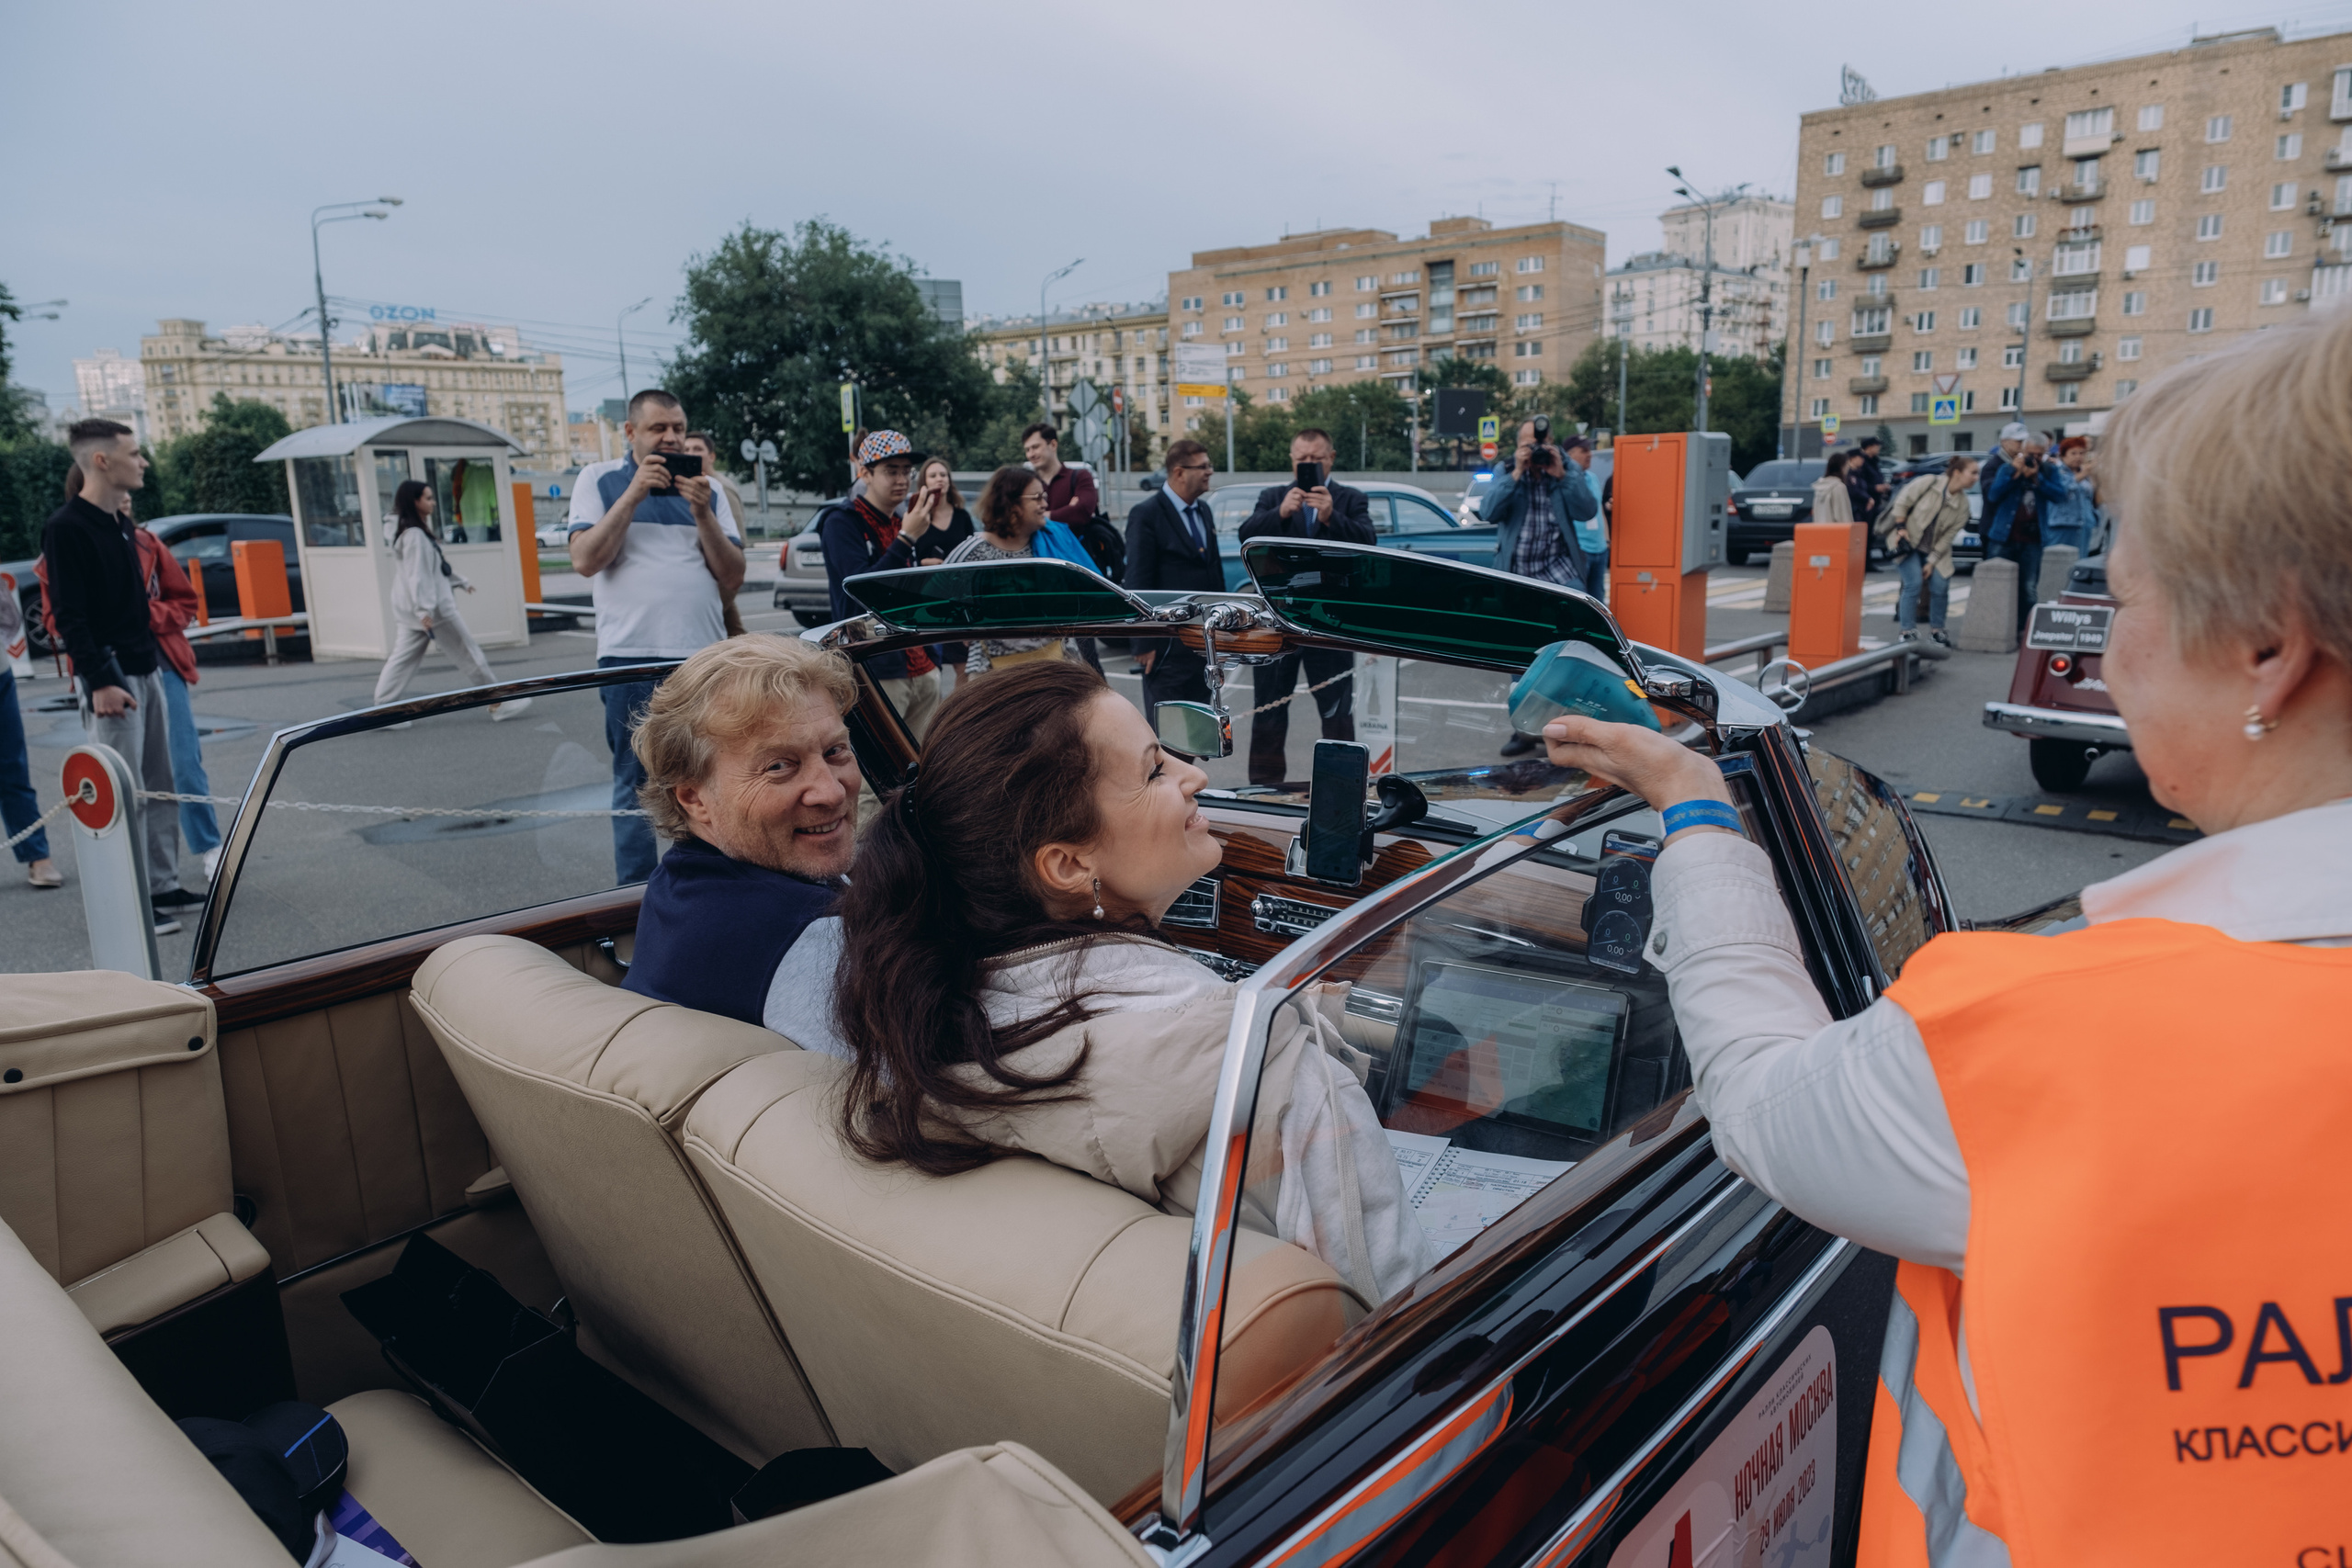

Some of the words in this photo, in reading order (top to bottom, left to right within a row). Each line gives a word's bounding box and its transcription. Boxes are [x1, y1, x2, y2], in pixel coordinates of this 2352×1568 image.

[369, 305, 436, 320] OZON
[2051, 610, 2092, 626] Willys
[1615, 892, 1632, 902] 0,00
[1605, 928, 1611, 936] 0
[1607, 944, 1623, 955] 0,00
[1758, 1397, 1775, 1420] РАЛЛИ
[1776, 1353, 1812, 1399] КЛАССИЧЕСКИХ
[1770, 1371, 1804, 1417] АВТОМОБИЛЕЙ
[1734, 1421, 1784, 1522] НОЧНАЯ
[1789, 1360, 1834, 1455] МОСКВА
[1759, 1518, 1770, 1556] 29
[1773, 1484, 1795, 1539] ИЮЛЯ
[1797, 1458, 1816, 1506] 2023
